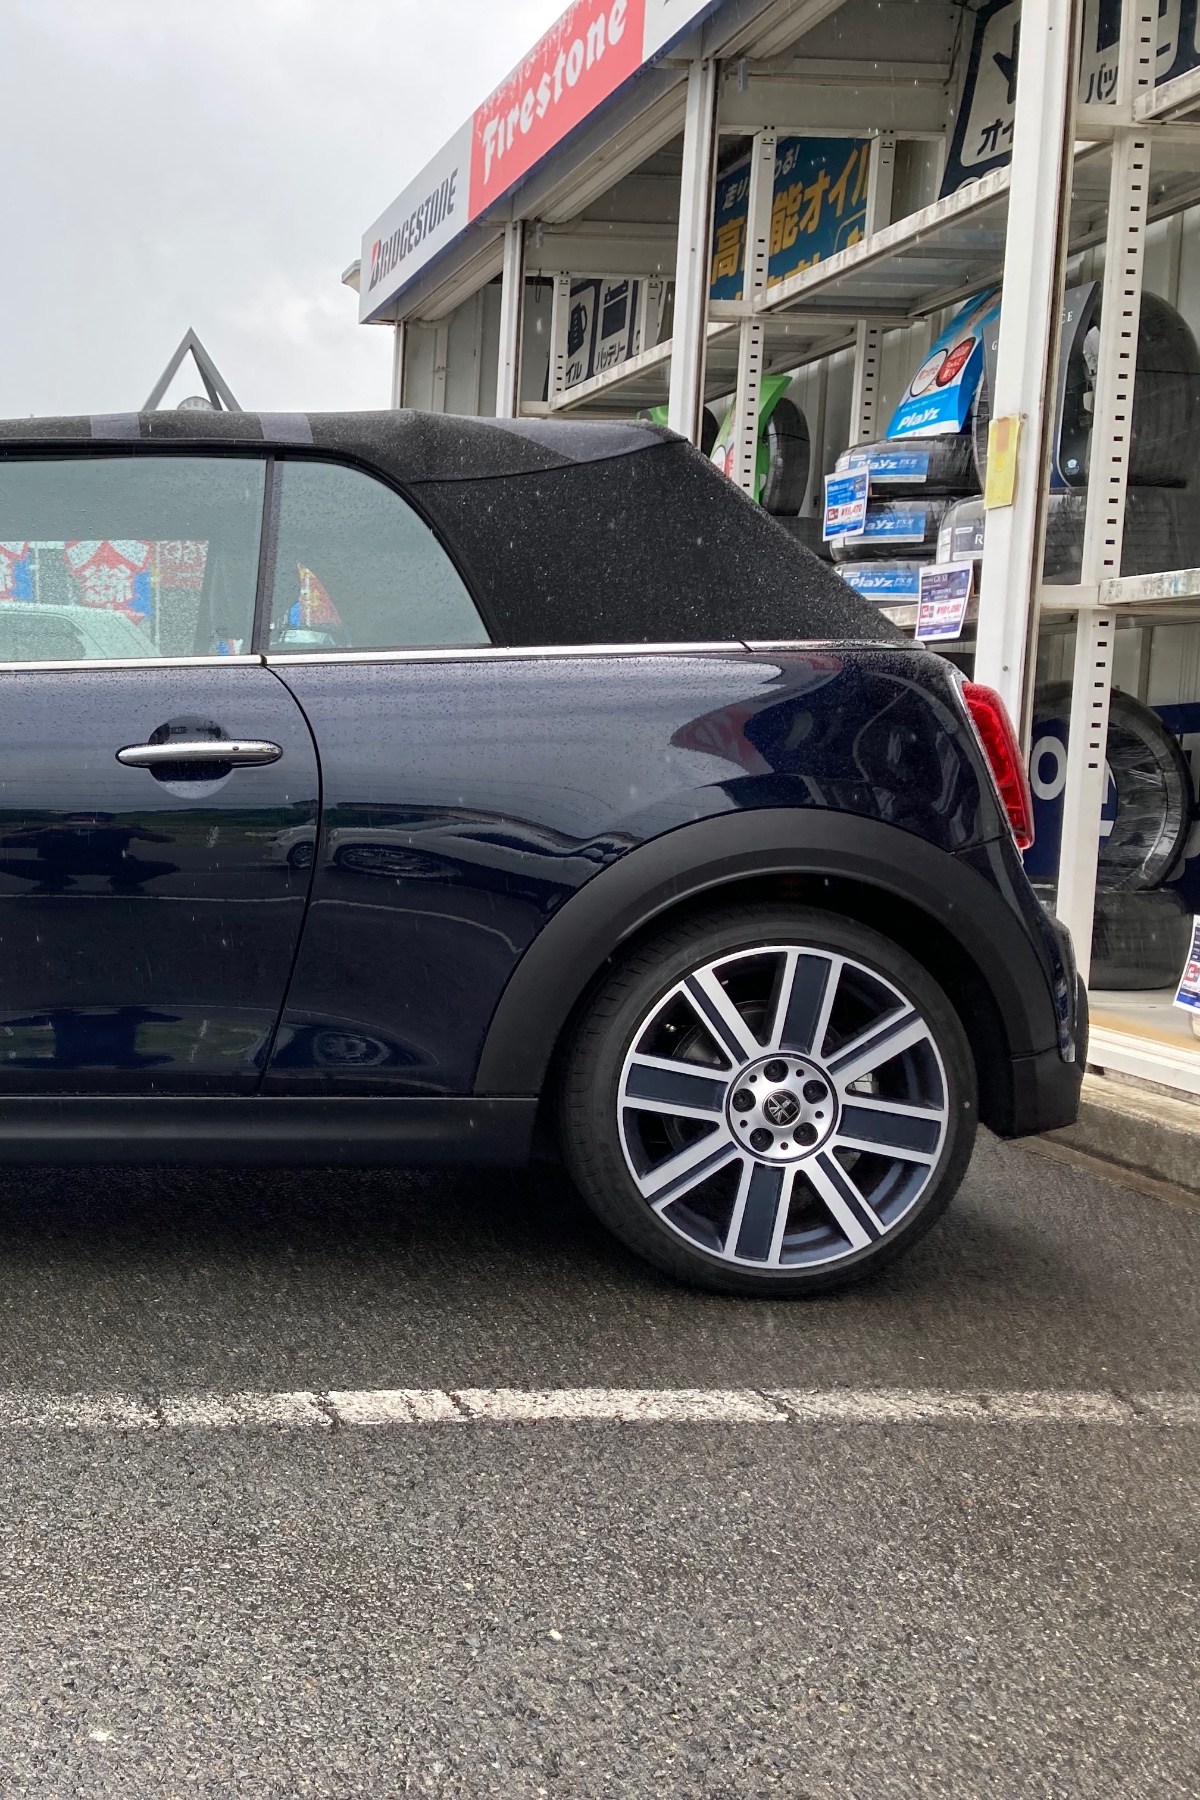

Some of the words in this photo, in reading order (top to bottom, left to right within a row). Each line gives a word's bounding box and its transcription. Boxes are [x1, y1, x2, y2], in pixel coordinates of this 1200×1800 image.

[482, 0, 628, 185] Firestone
[368, 167, 458, 292] BRIDGESTONE
[596, 341, 626, 371] バッテリー
[897, 407, 941, 431] Playz
[850, 576, 893, 588] Playz
